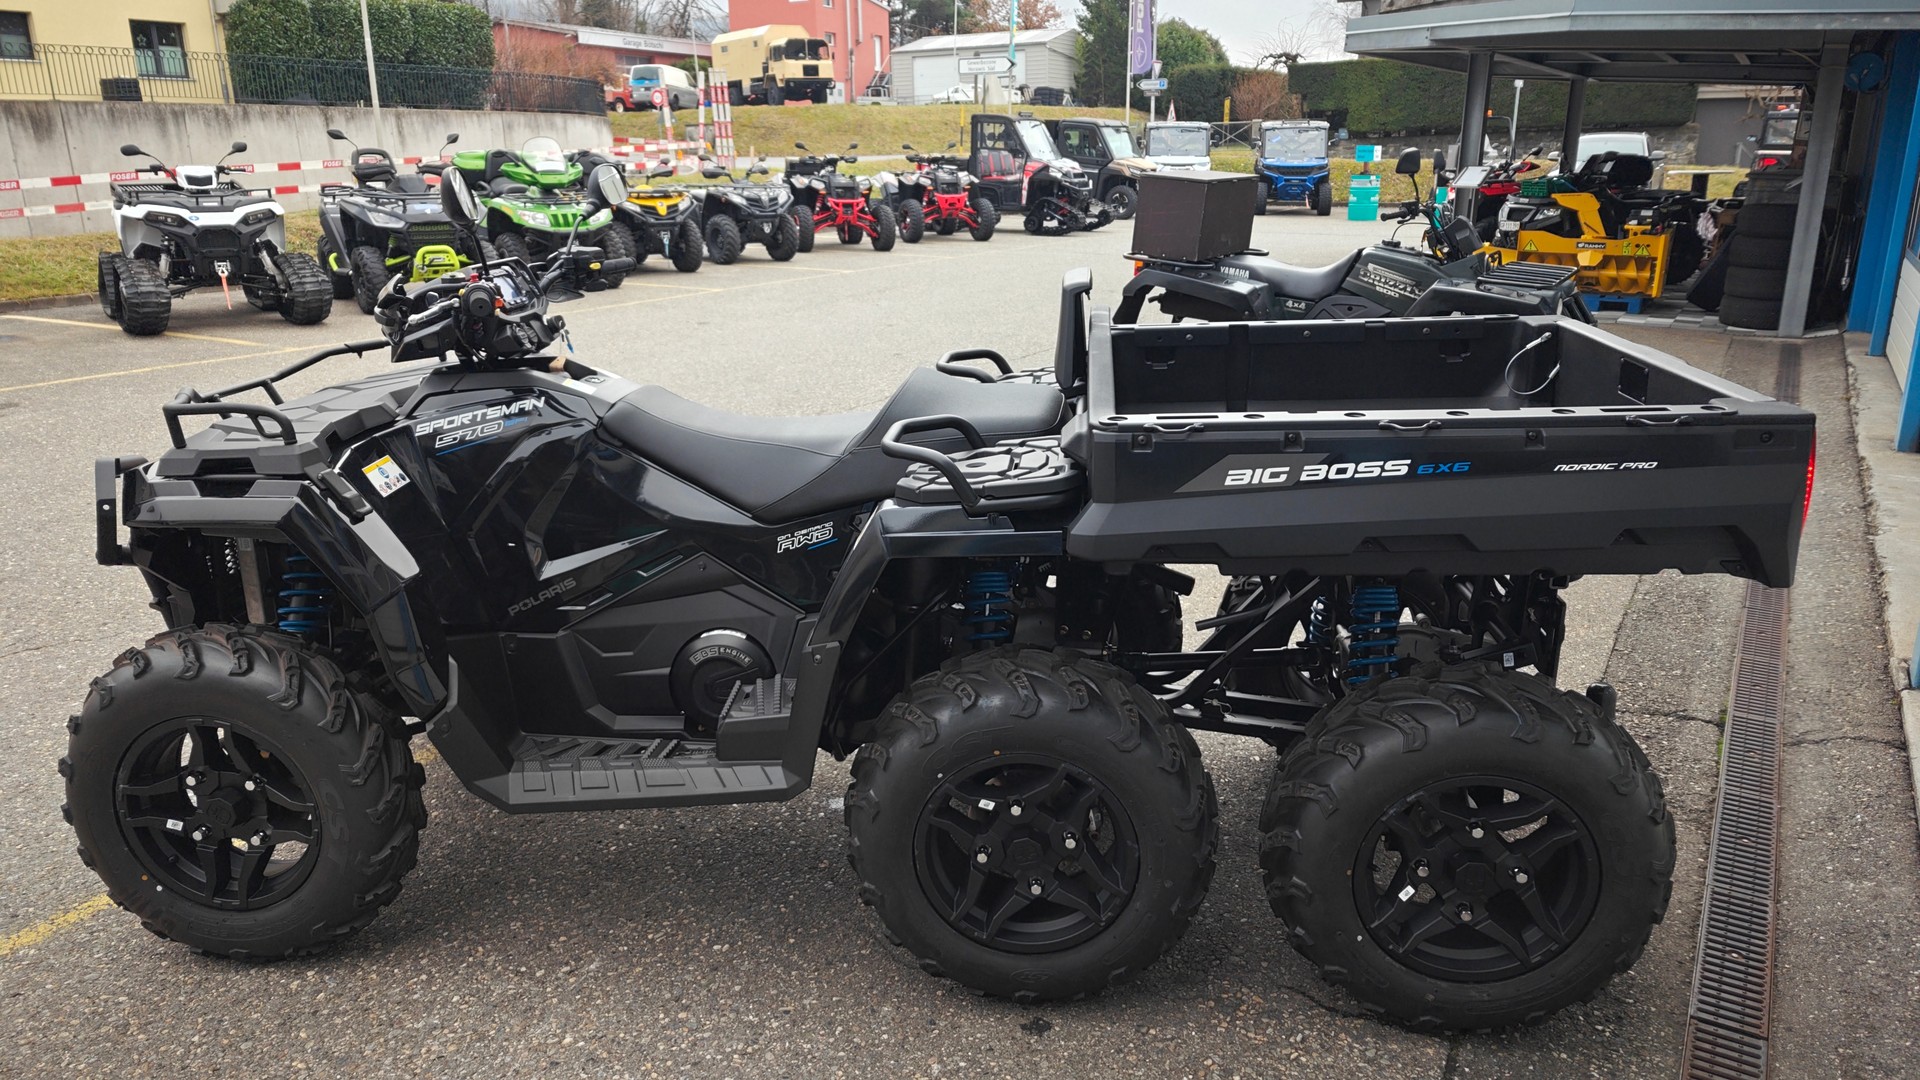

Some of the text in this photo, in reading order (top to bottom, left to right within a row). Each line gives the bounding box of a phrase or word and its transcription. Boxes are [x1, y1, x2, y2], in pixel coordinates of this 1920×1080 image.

[622, 37, 642, 48] Garage
[111, 172, 137, 181] FOSER
[1219, 265, 1250, 279] YAMAHA
[414, 396, 546, 437] SPORTSMAN
[434, 420, 505, 448] 570
[1224, 466, 1290, 486] BIG
[1299, 459, 1412, 481] BOSS
[1553, 461, 1659, 472] NORDIC PRO
[794, 521, 834, 537] DEMAND
[777, 527, 834, 554] AWD
[507, 577, 577, 616] POLARIS
[720, 646, 752, 664] ENGINE
